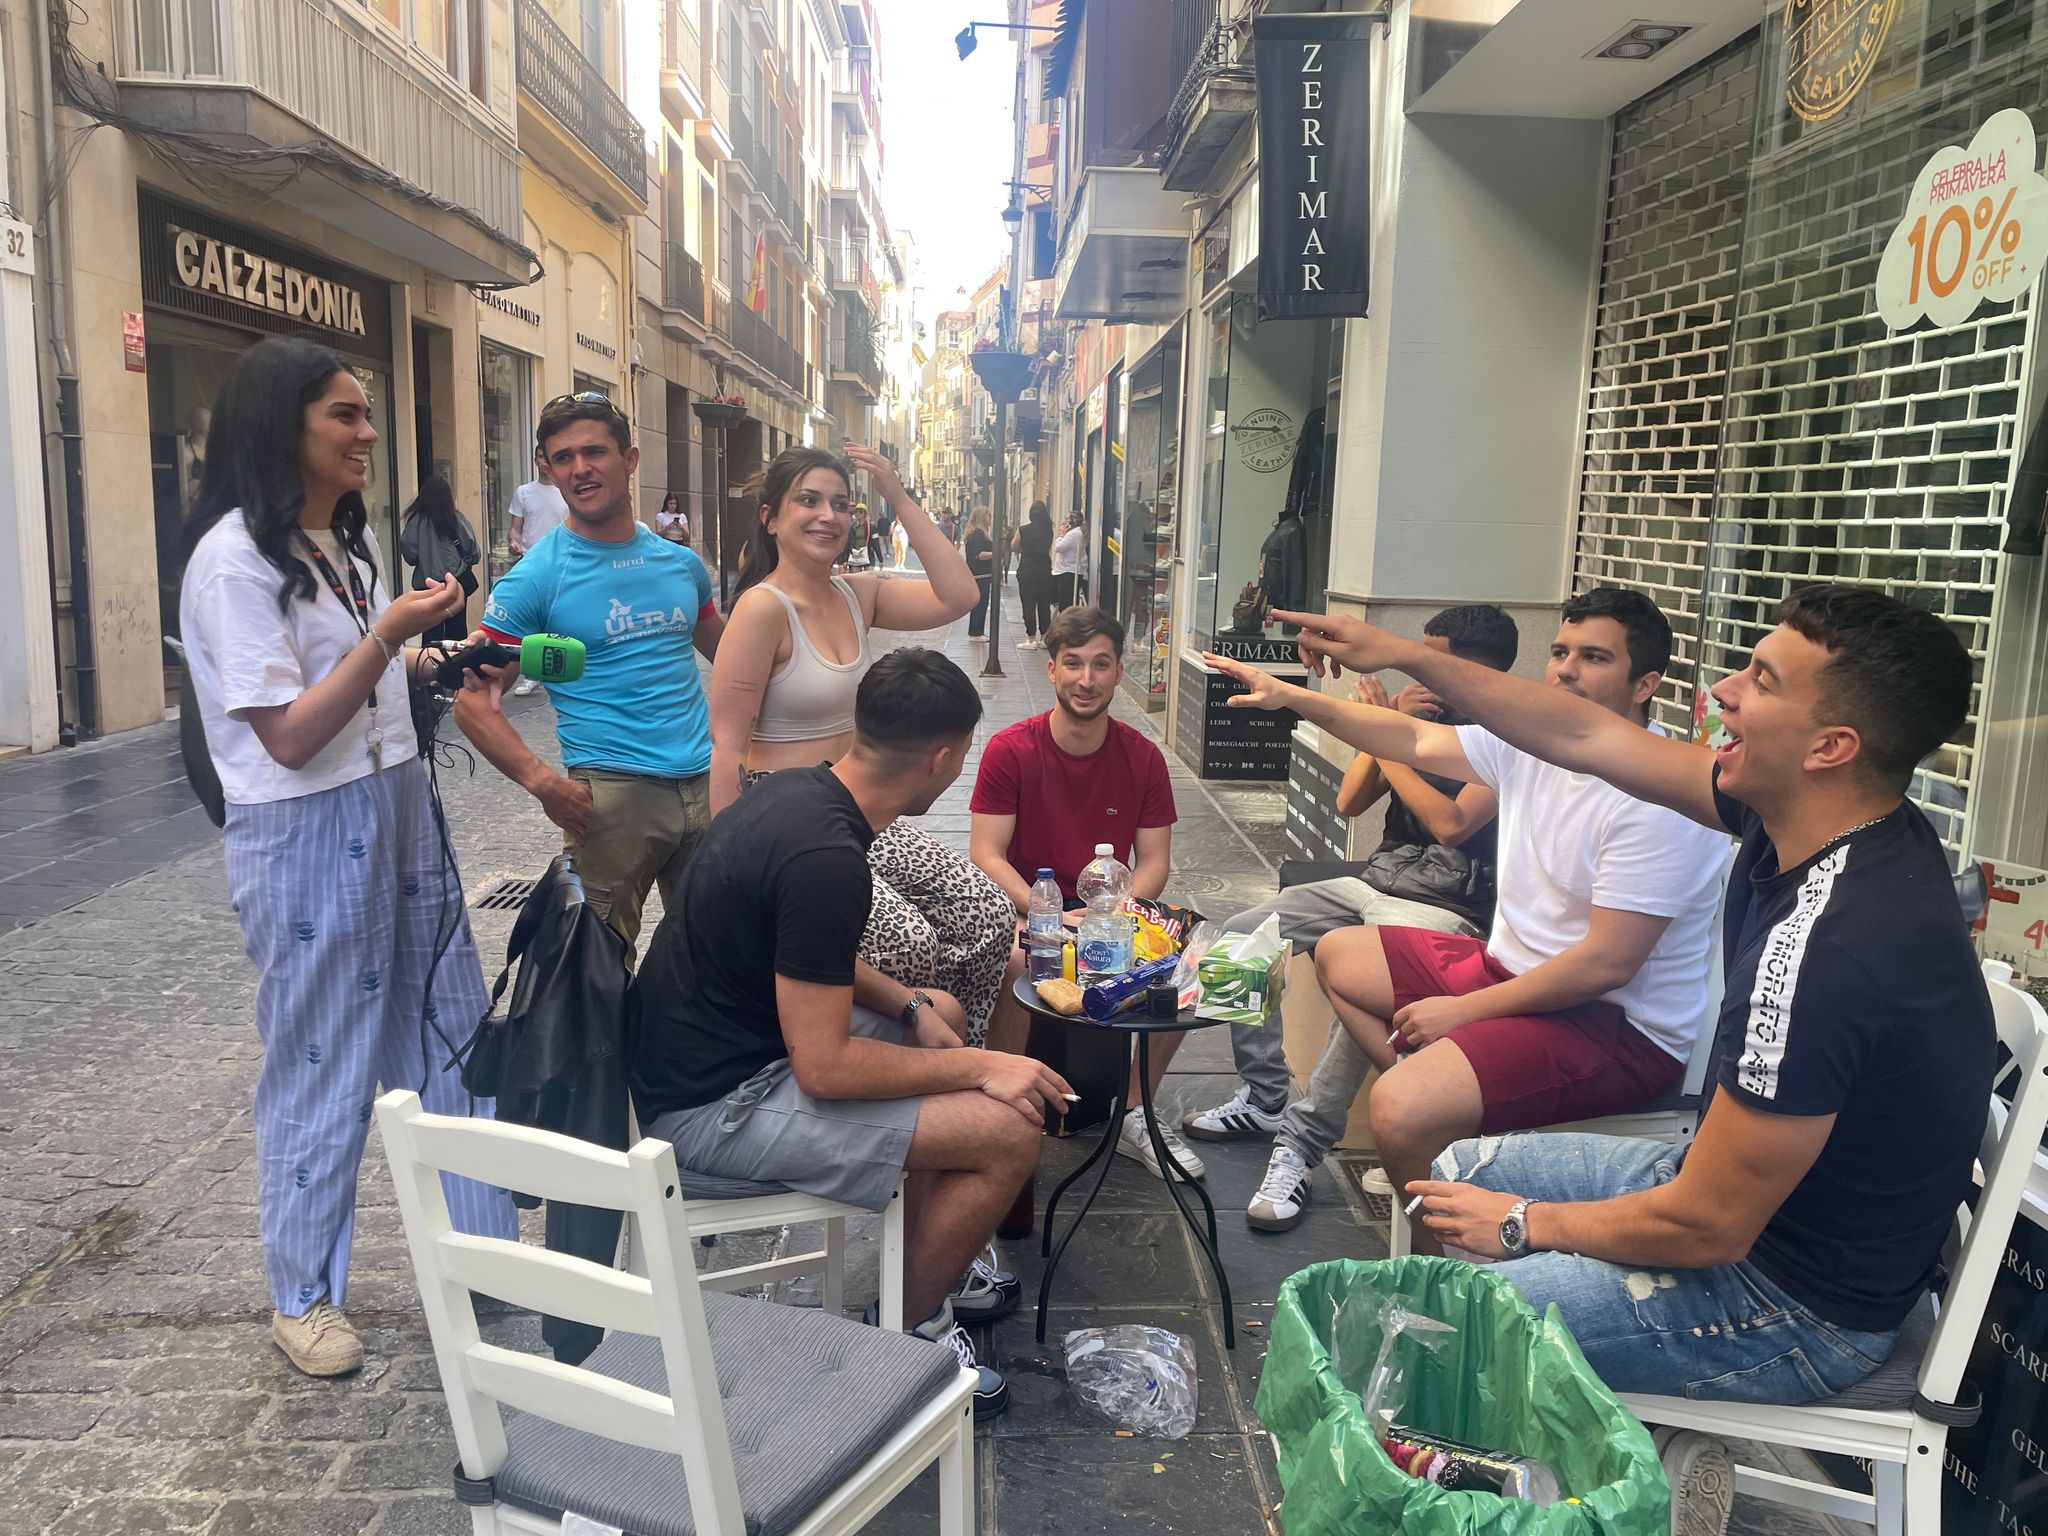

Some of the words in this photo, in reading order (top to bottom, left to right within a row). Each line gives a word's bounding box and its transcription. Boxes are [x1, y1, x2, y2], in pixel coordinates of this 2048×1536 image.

[1801, 3, 1884, 100] LEATHER
[1298, 44, 1328, 291] ZERIMAR
[1929, 165, 2007, 205] PRIMAVERA
[1931, 157, 1984, 189] CELEBRA
[1988, 148, 2006, 173] LA
[7, 229, 25, 257] 32
[1907, 186, 2021, 305] 10%
[175, 231, 366, 336] CALZEDONIA
[1972, 256, 2015, 290] OFF
[1250, 444, 1291, 467] LEATHER
[613, 555, 645, 569] land
[605, 606, 688, 636] ULTRA
[2001, 1247, 2046, 1291] RAS
